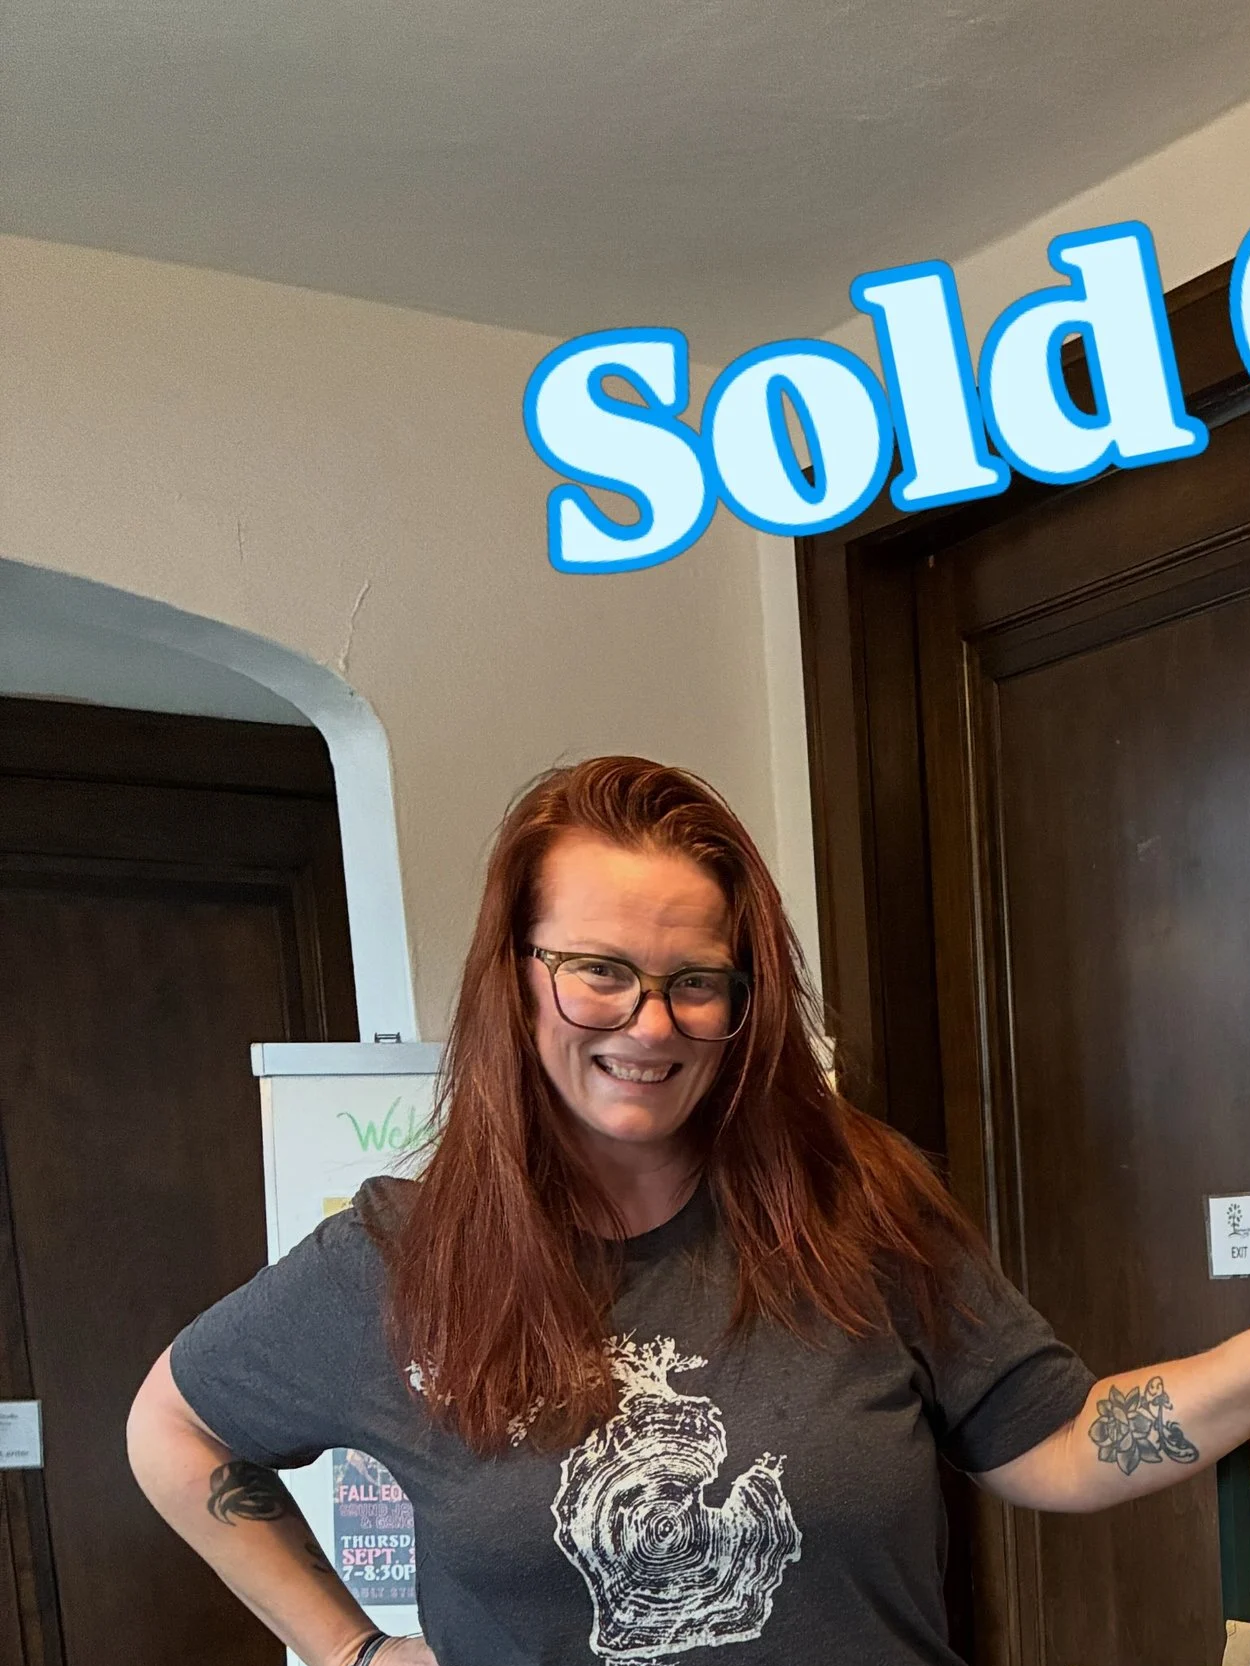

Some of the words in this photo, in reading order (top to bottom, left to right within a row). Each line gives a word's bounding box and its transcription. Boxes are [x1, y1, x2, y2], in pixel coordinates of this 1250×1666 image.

[1231, 1246, 1248, 1259] EXIT
[339, 1484, 378, 1502] FALL
[342, 1549, 399, 1565] SEPT.
